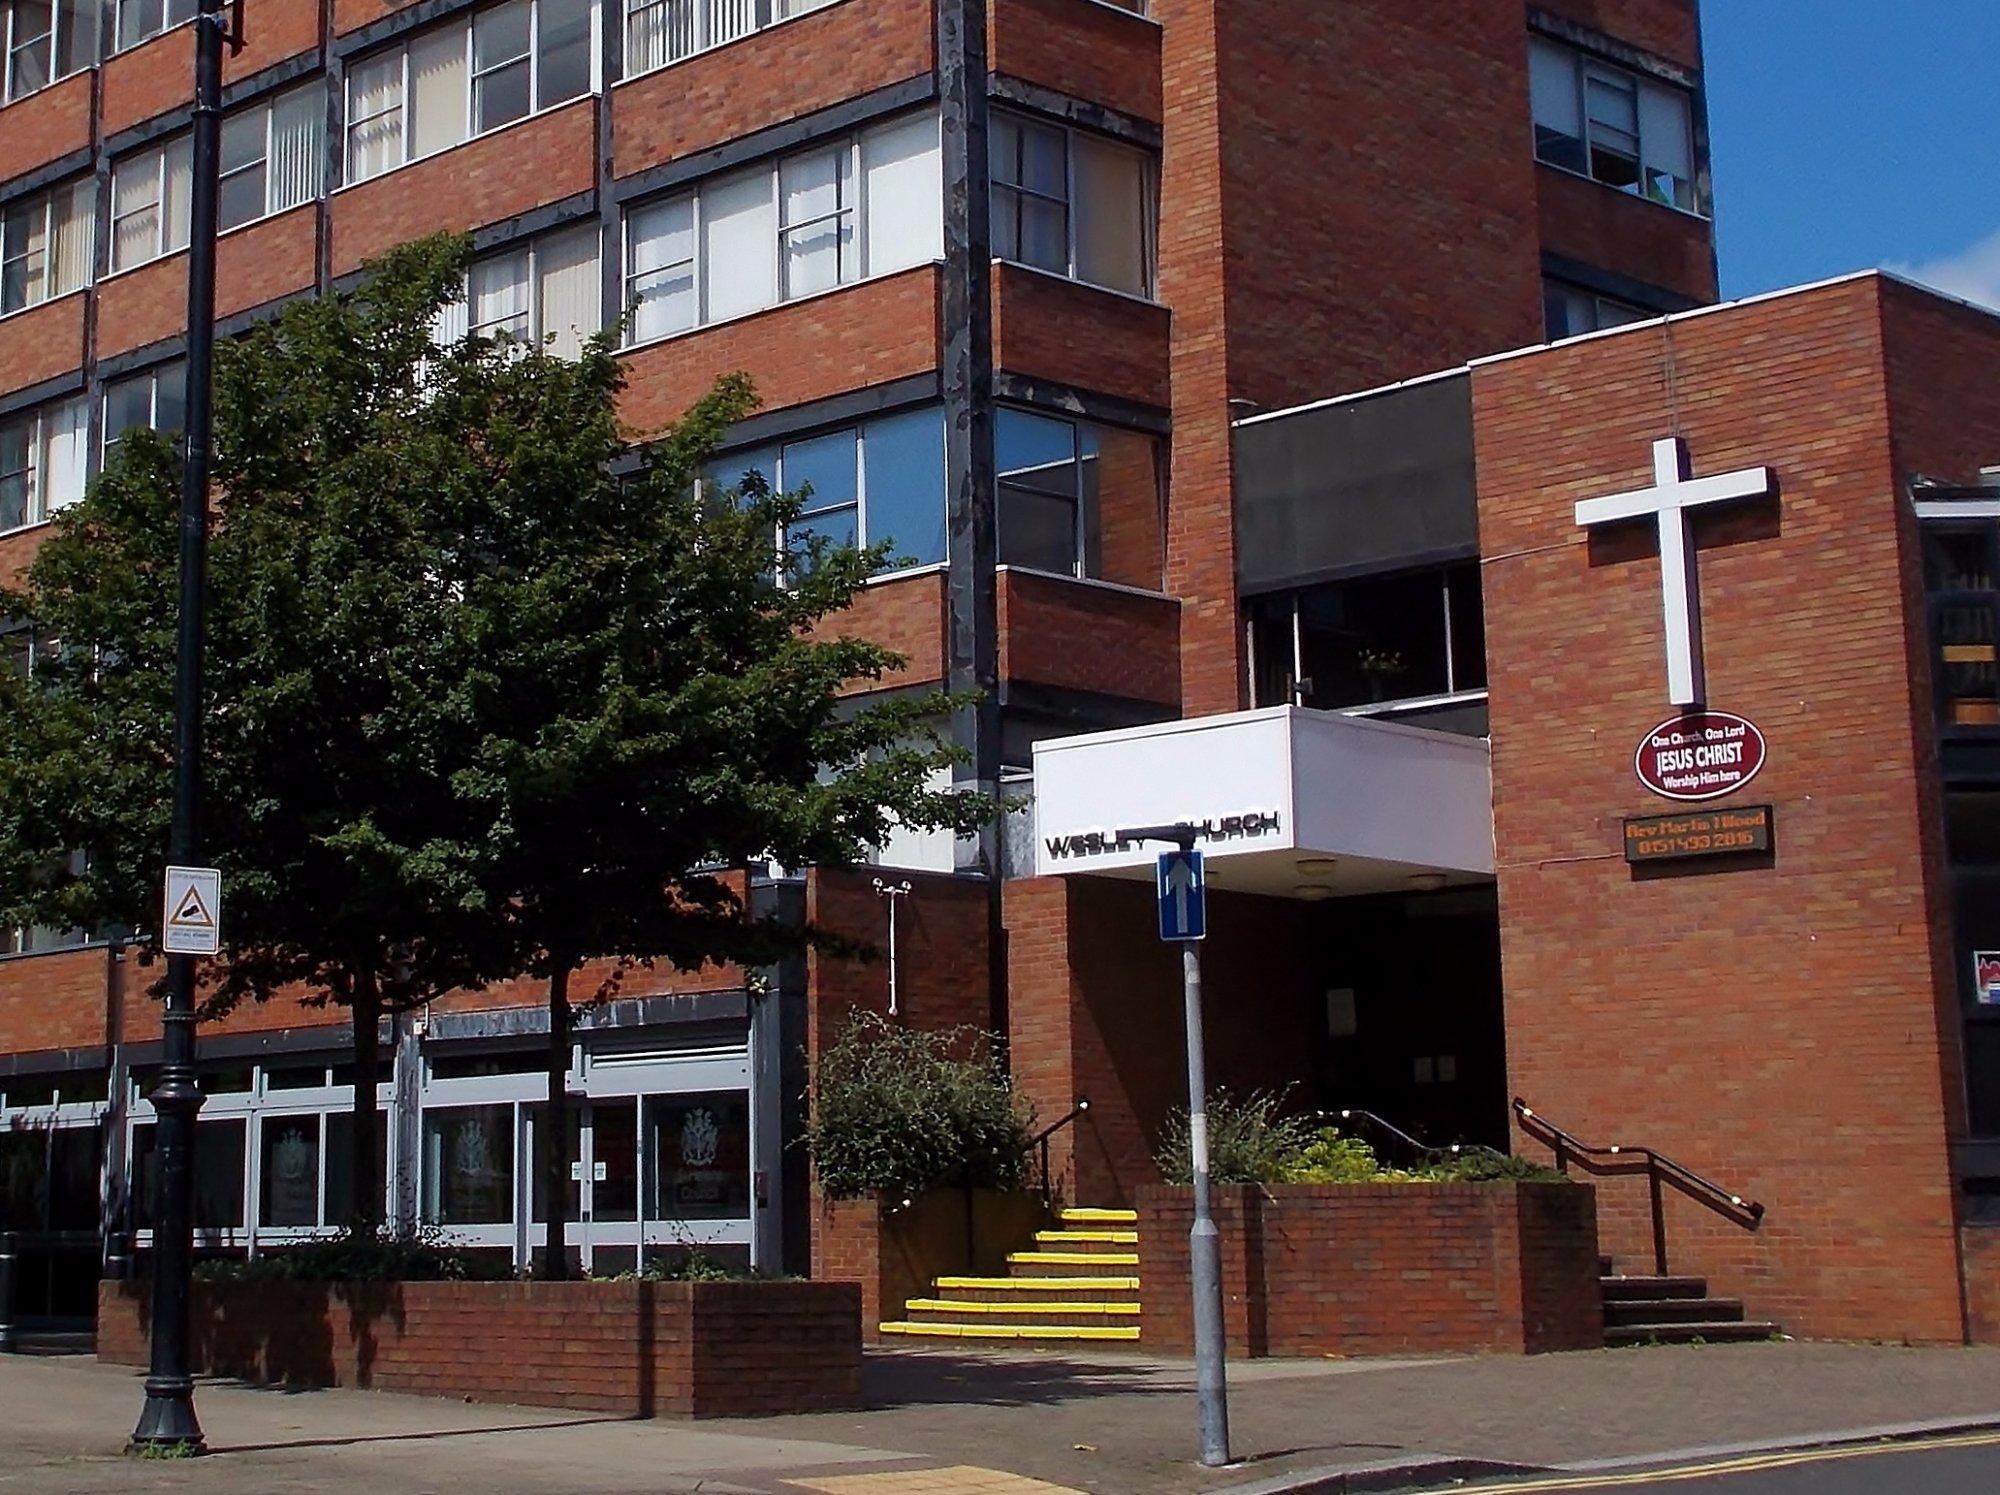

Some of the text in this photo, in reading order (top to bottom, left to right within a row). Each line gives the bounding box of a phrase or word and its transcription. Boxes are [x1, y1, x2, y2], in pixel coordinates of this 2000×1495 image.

[1651, 736, 1670, 748] One
[1705, 728, 1724, 741] One
[1725, 724, 1745, 738] Lord
[1656, 741, 1744, 777] JESUS CHRIST
[1663, 770, 1741, 789] Worship Him here
[1174, 811, 1280, 843] HURCH
